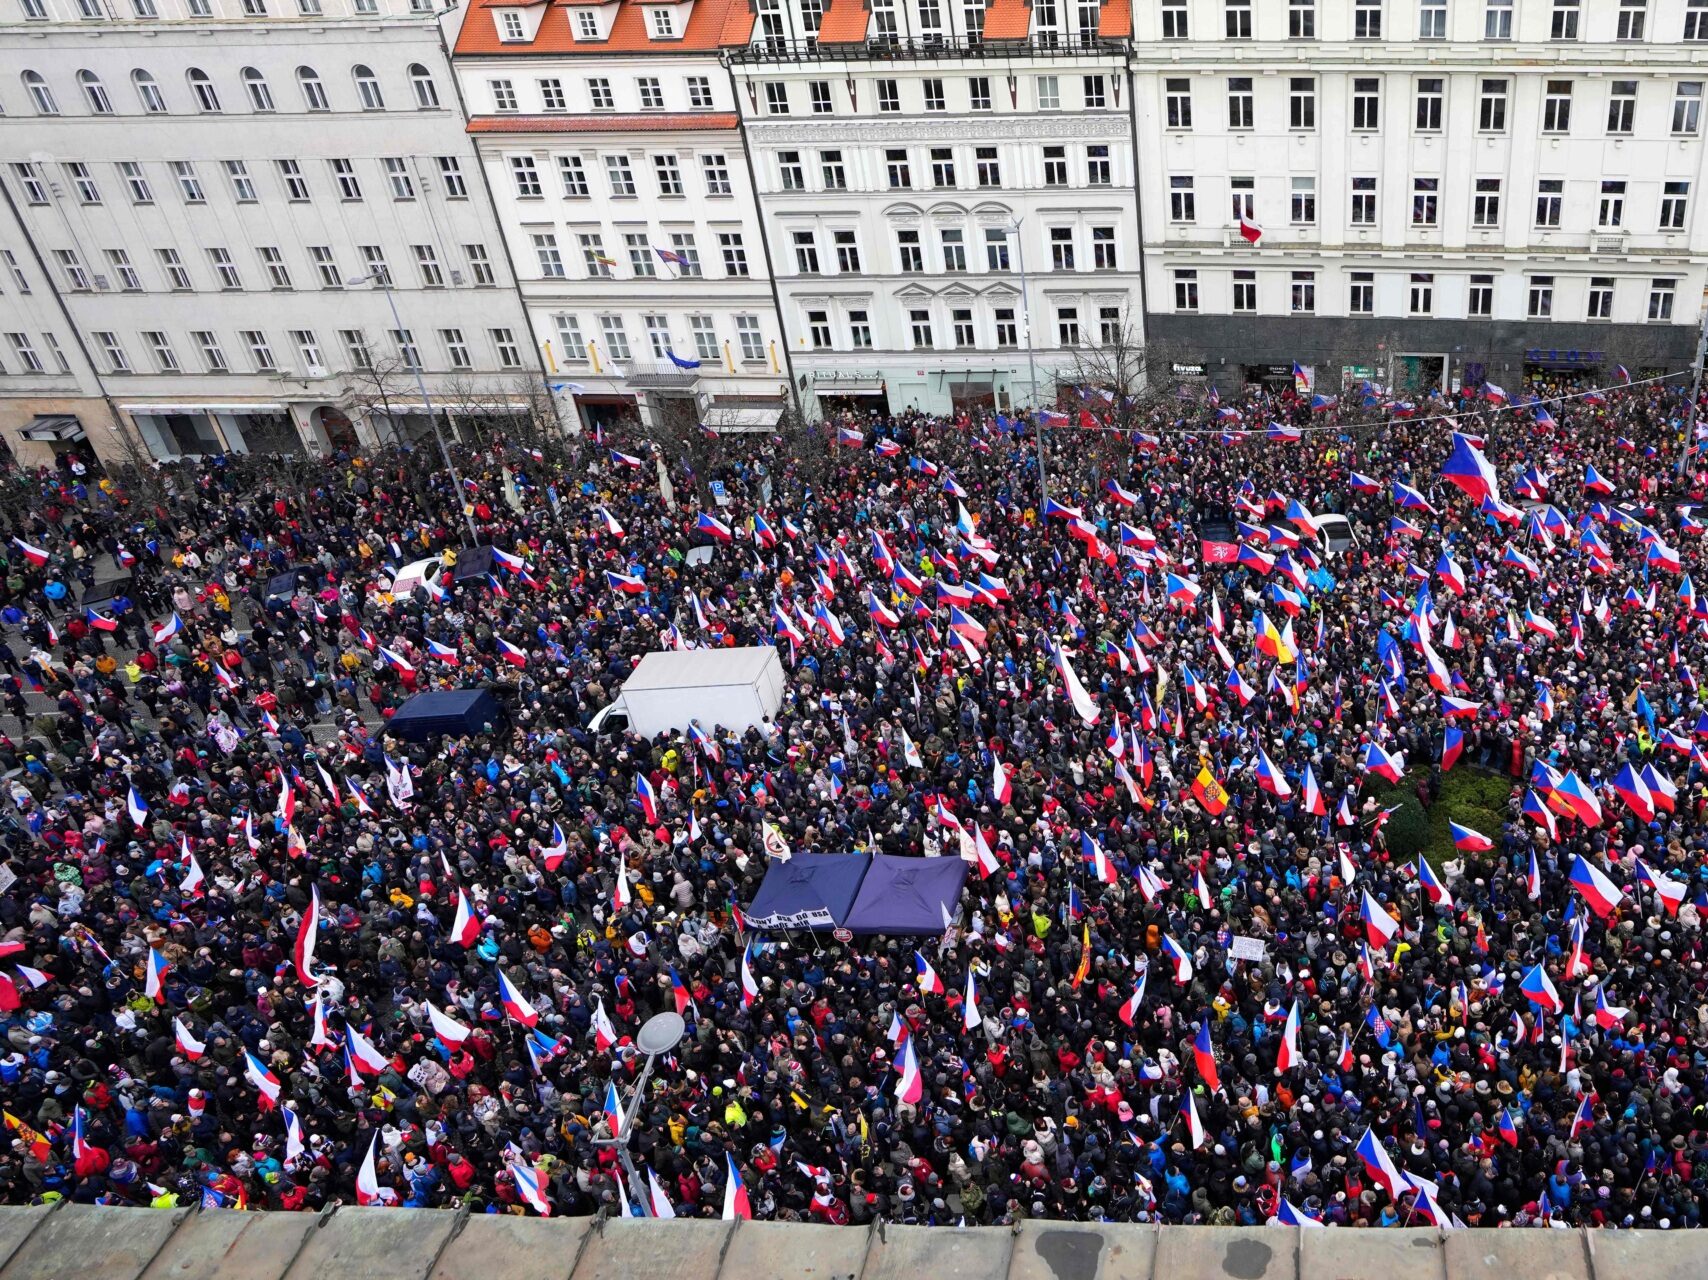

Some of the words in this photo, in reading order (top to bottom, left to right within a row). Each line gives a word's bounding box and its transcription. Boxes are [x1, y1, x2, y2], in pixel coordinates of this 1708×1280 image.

[714, 483, 722, 491] P
[777, 914, 793, 923] USA
[796, 912, 808, 921] DO
[811, 910, 829, 918] USA
